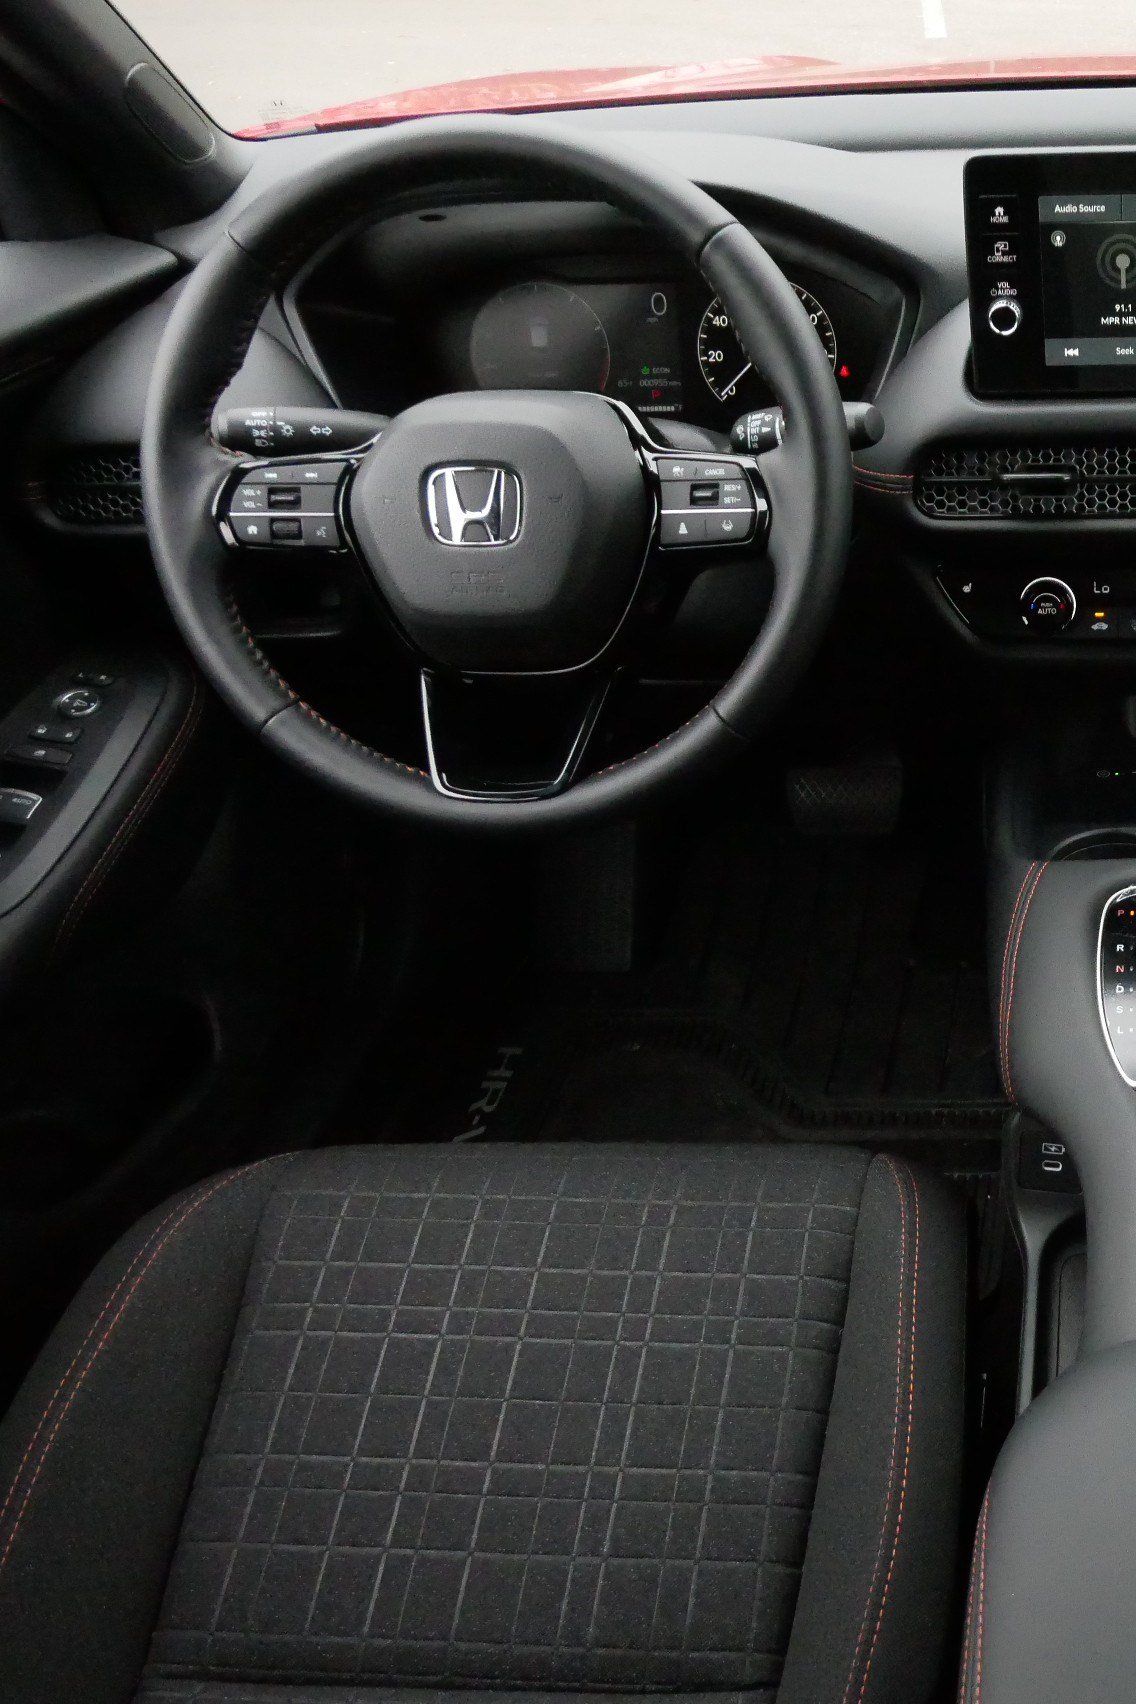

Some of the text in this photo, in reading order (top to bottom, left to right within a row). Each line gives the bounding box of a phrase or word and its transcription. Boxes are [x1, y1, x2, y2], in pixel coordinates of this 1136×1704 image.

[1054, 204, 1106, 213] Audio Source
[987, 255, 1017, 263] CONNECT
[997, 288, 1018, 296] AUDIO
[651, 292, 667, 316] 0
[1114, 303, 1133, 312] 91.1
[712, 315, 728, 327] 40
[1101, 316, 1121, 325] MPR
[1115, 346, 1135, 356] Seek
[708, 350, 724, 362] 20
[242, 500, 256, 508] VOL
[1117, 909, 1125, 917] P
[1116, 943, 1125, 952] R
[1115, 964, 1125, 973] N
[1115, 984, 1125, 993] D
[1116, 1005, 1124, 1014] S
[1117, 1025, 1124, 1034] L
